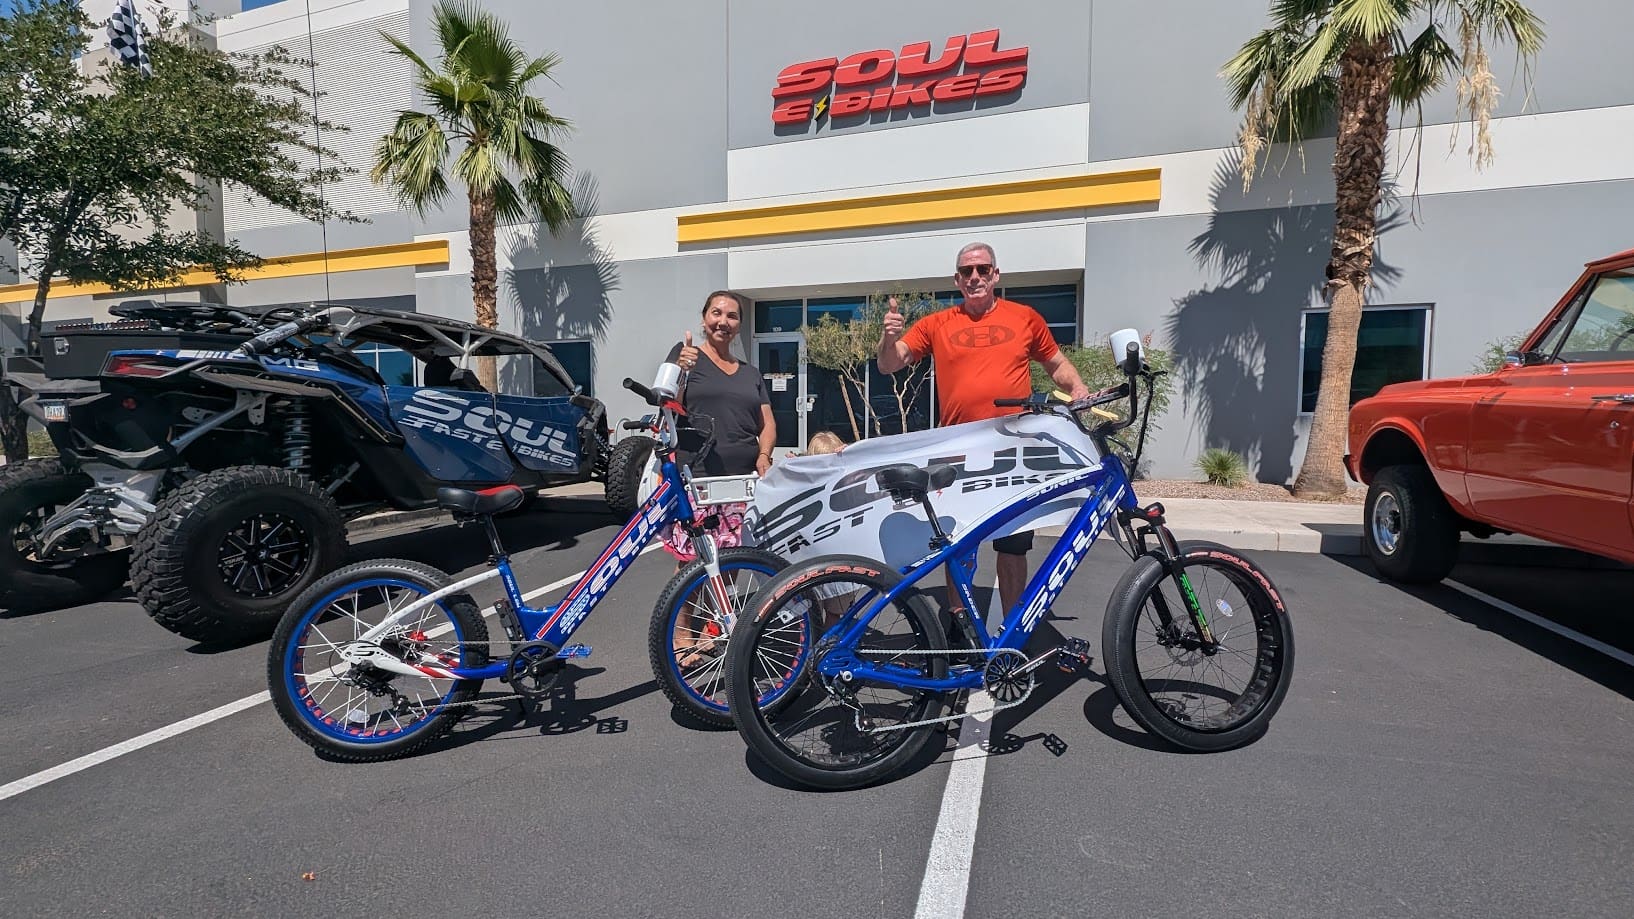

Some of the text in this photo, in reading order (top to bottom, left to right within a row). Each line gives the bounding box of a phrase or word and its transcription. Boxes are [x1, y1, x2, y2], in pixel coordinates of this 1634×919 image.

[771, 29, 1029, 97] SOUL
[828, 65, 1028, 119] BIKES
[397, 414, 489, 444] FAST
[517, 444, 576, 468] BIKES
[403, 389, 577, 458] SOUL
[961, 471, 1069, 494] BIK
[559, 495, 678, 635] SOUL
[1021, 484, 1125, 633] SOUL
